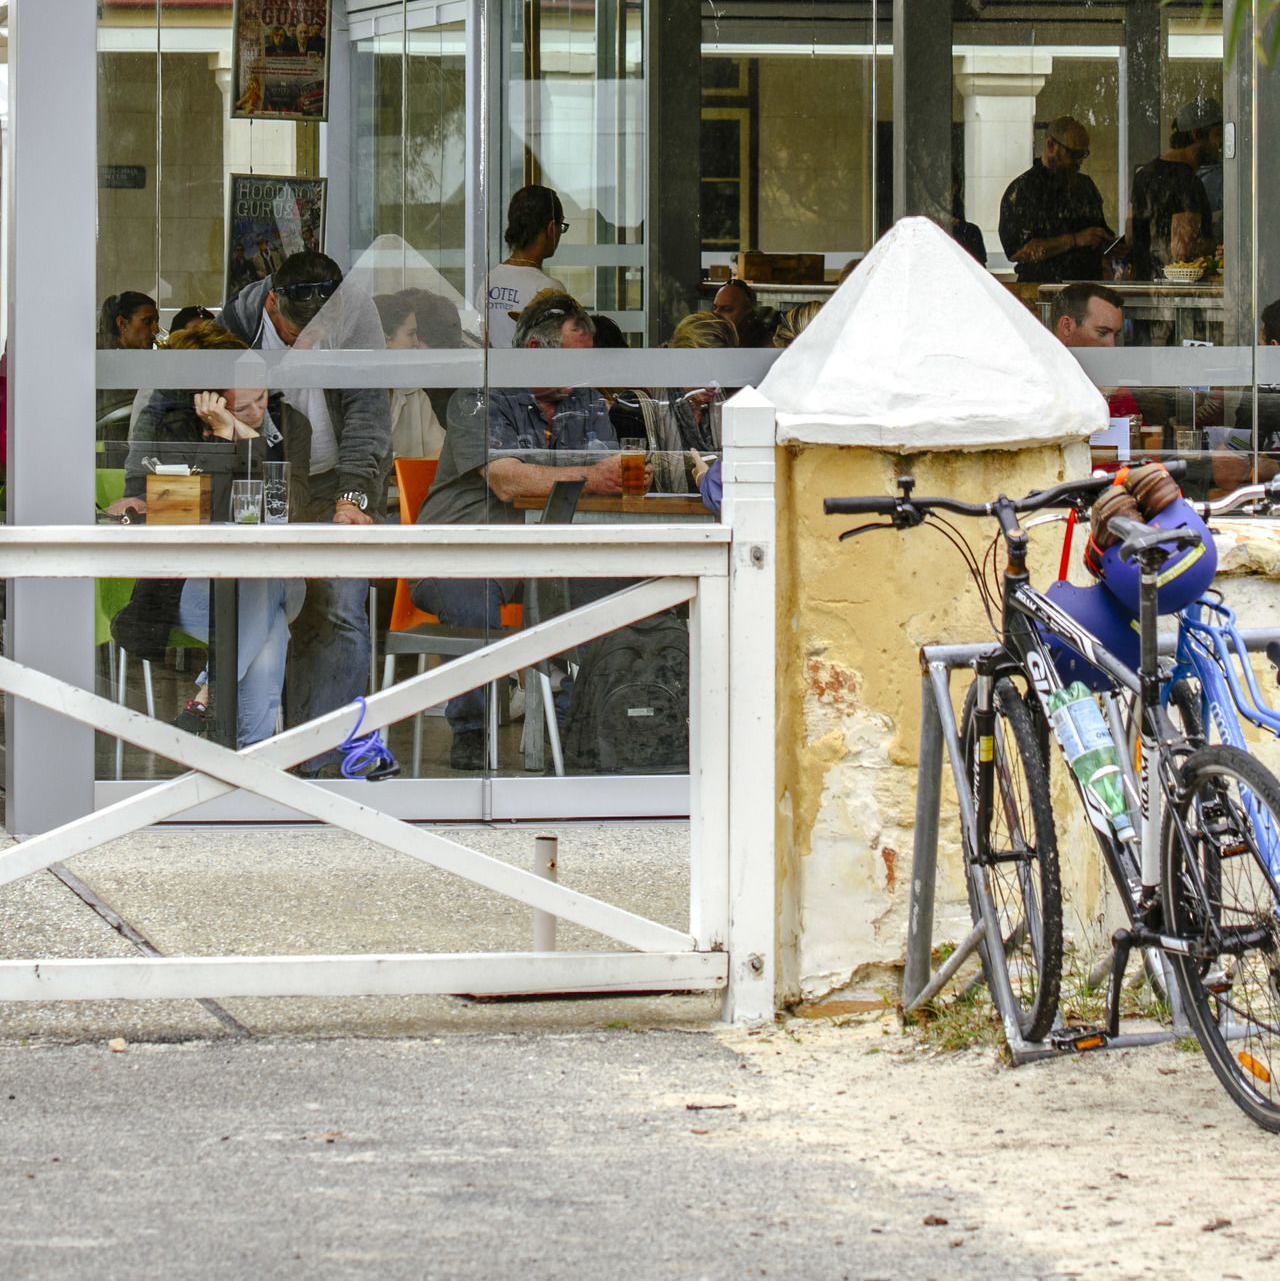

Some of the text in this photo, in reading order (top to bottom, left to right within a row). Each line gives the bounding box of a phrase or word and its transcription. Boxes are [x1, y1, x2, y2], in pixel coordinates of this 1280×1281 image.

[239, 183, 312, 202] HOODOO
[236, 200, 293, 219] GURUS
[489, 286, 520, 304] OTEL
[1140, 756, 1150, 821] ROAM
